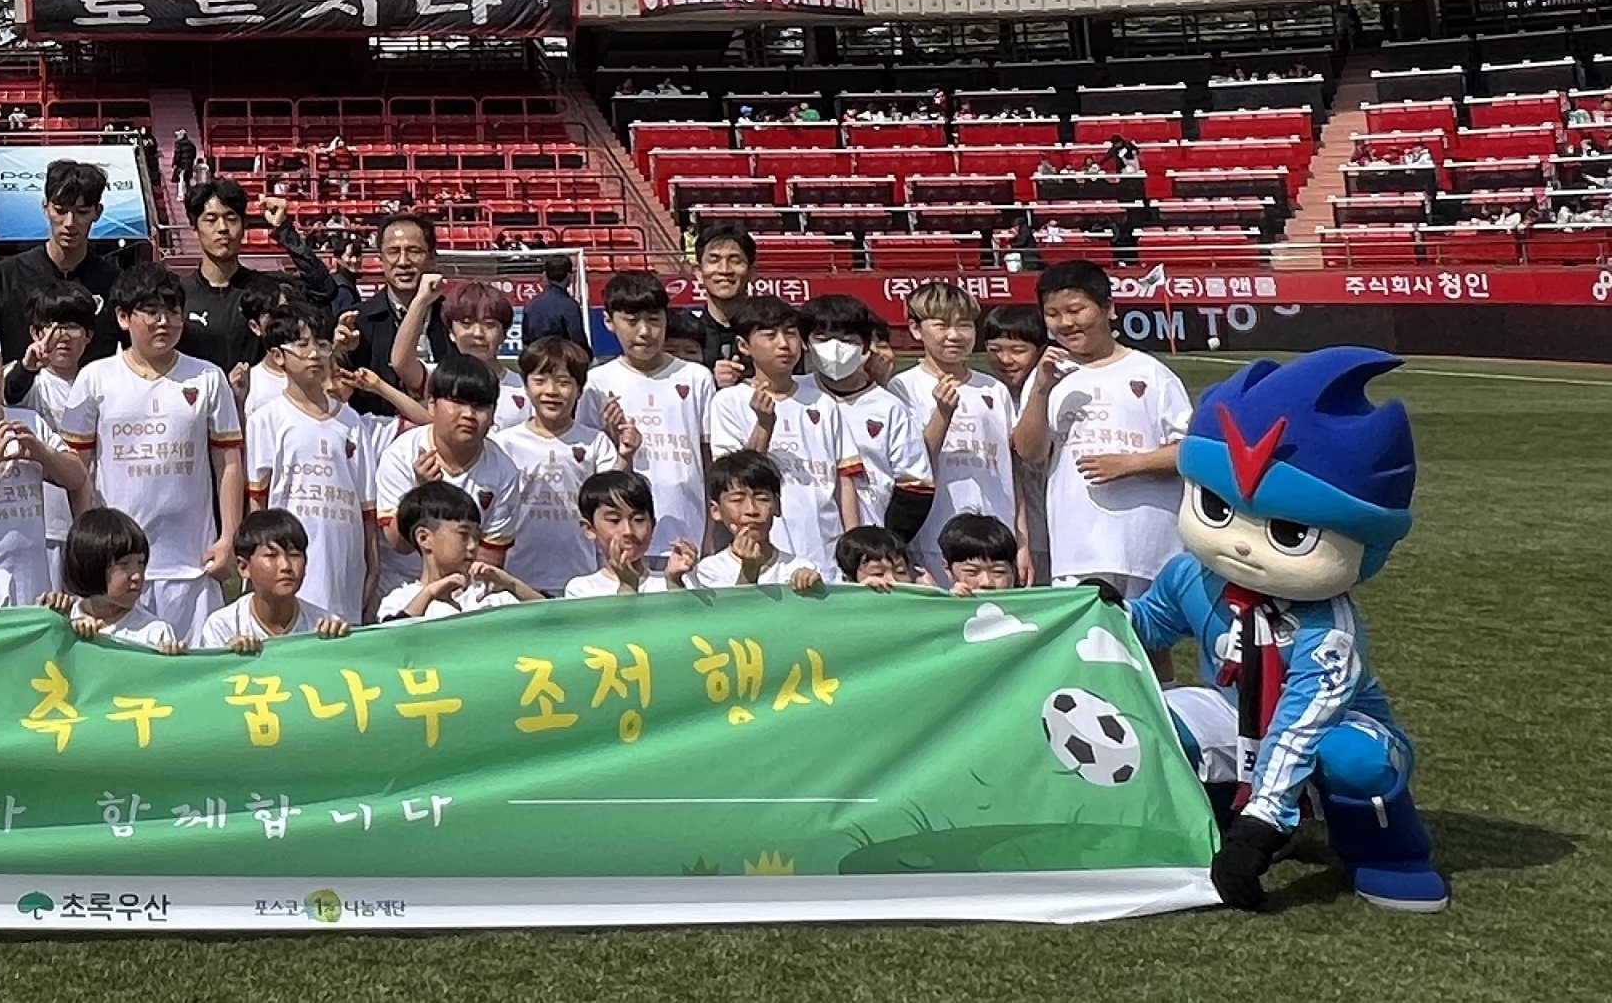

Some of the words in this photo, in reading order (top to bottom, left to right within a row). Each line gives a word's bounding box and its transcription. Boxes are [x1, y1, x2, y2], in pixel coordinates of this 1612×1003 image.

[1345, 276, 1434, 296] 주식회사
[1438, 271, 1490, 299] 청인
[112, 422, 167, 439] posco
[20, 660, 174, 753] 축구
[223, 667, 462, 747] 꿈나무
[691, 634, 840, 725] 행사
[96, 790, 454, 840] 함께합니다
[60, 892, 171, 922] 초록우산
[254, 899, 299, 917] 포스코
[343, 899, 407, 918] 나눔재단
